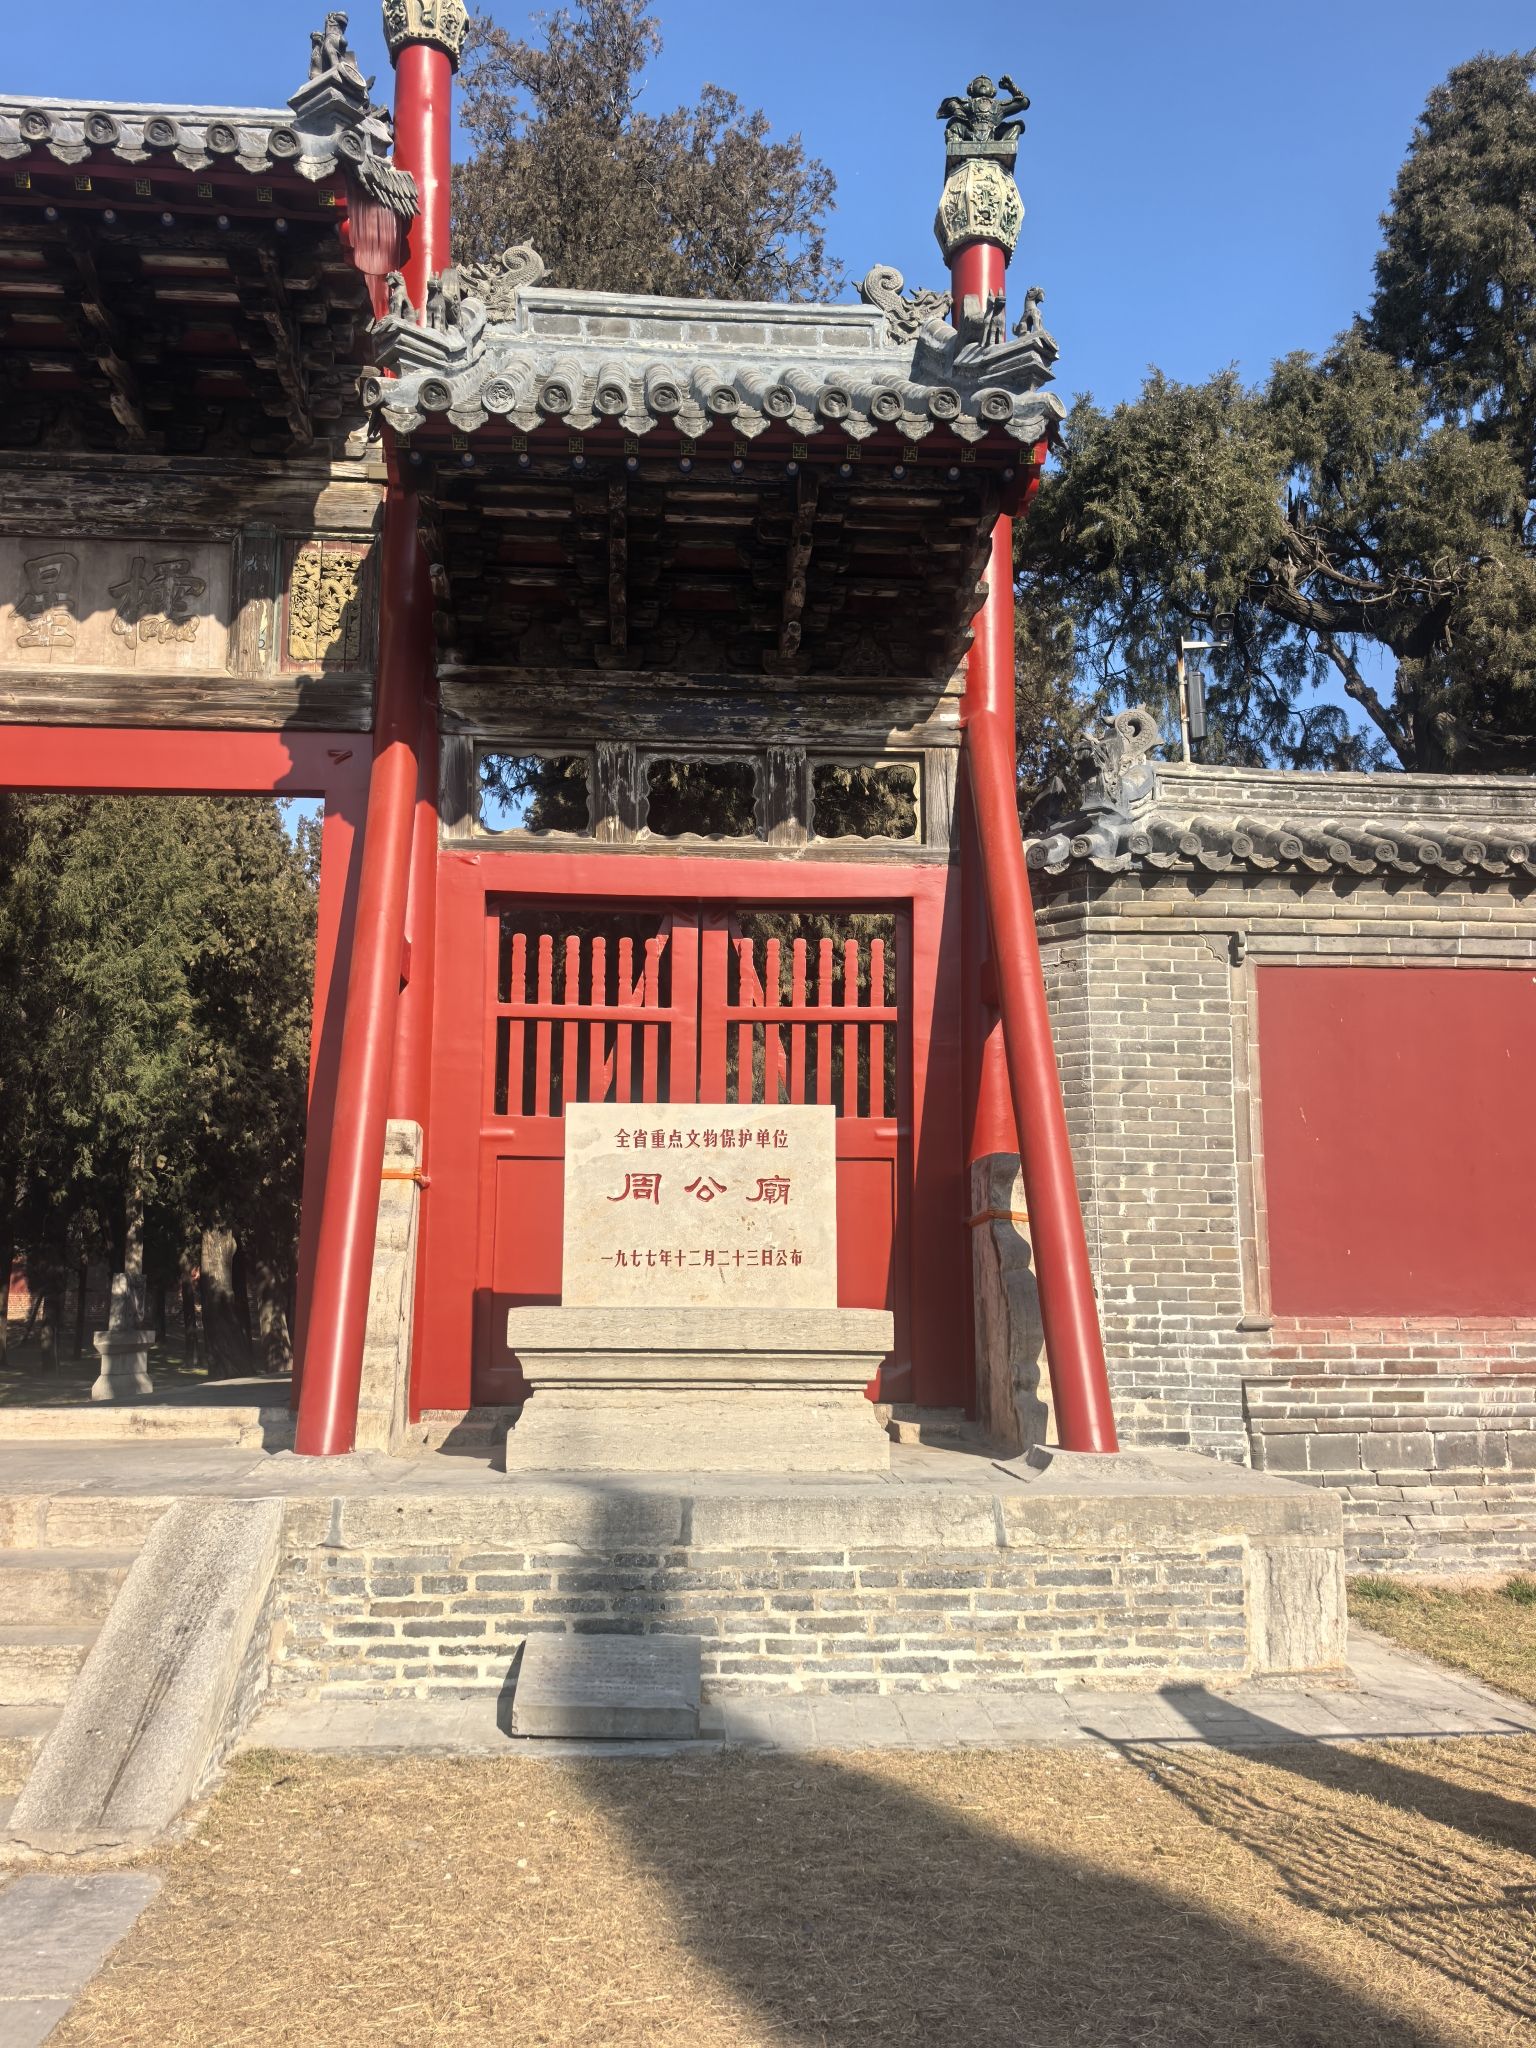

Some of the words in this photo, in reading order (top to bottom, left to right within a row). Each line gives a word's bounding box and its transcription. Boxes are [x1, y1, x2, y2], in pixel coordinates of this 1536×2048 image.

[614, 1128, 789, 1149] 全省重点文物保护单位
[606, 1173, 791, 1205] 周公廟
[600, 1249, 803, 1268] 一九七七年十二月二十三日公布
